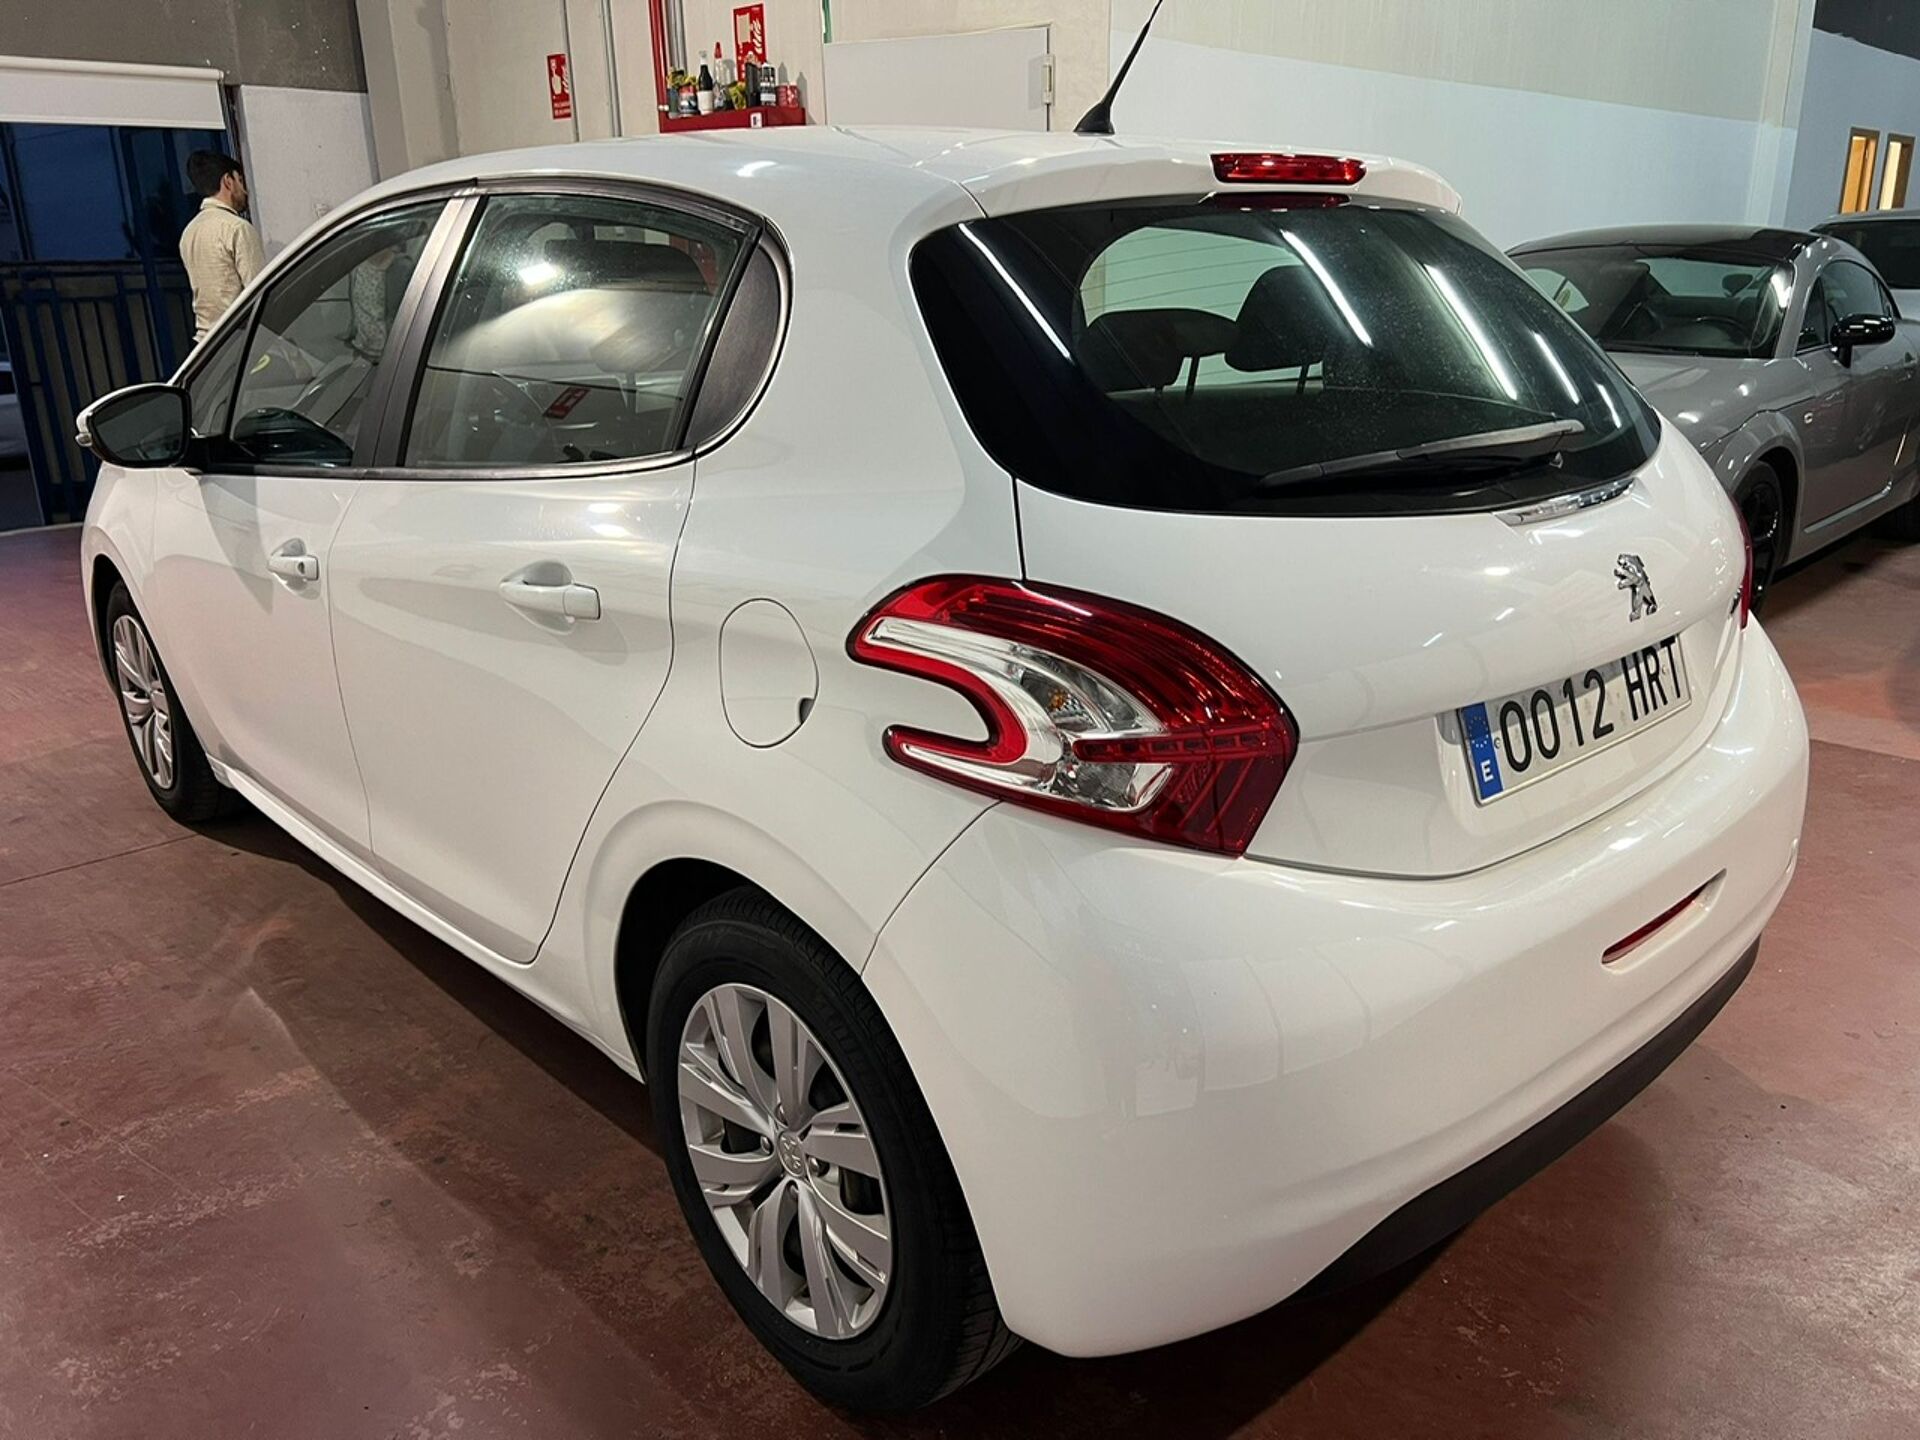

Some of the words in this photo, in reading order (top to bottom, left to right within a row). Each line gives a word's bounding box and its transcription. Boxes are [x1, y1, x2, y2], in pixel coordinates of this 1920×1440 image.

[1500, 669, 1614, 773] 0012
[1621, 637, 1681, 721] HRT
[1481, 760, 1493, 782] E
